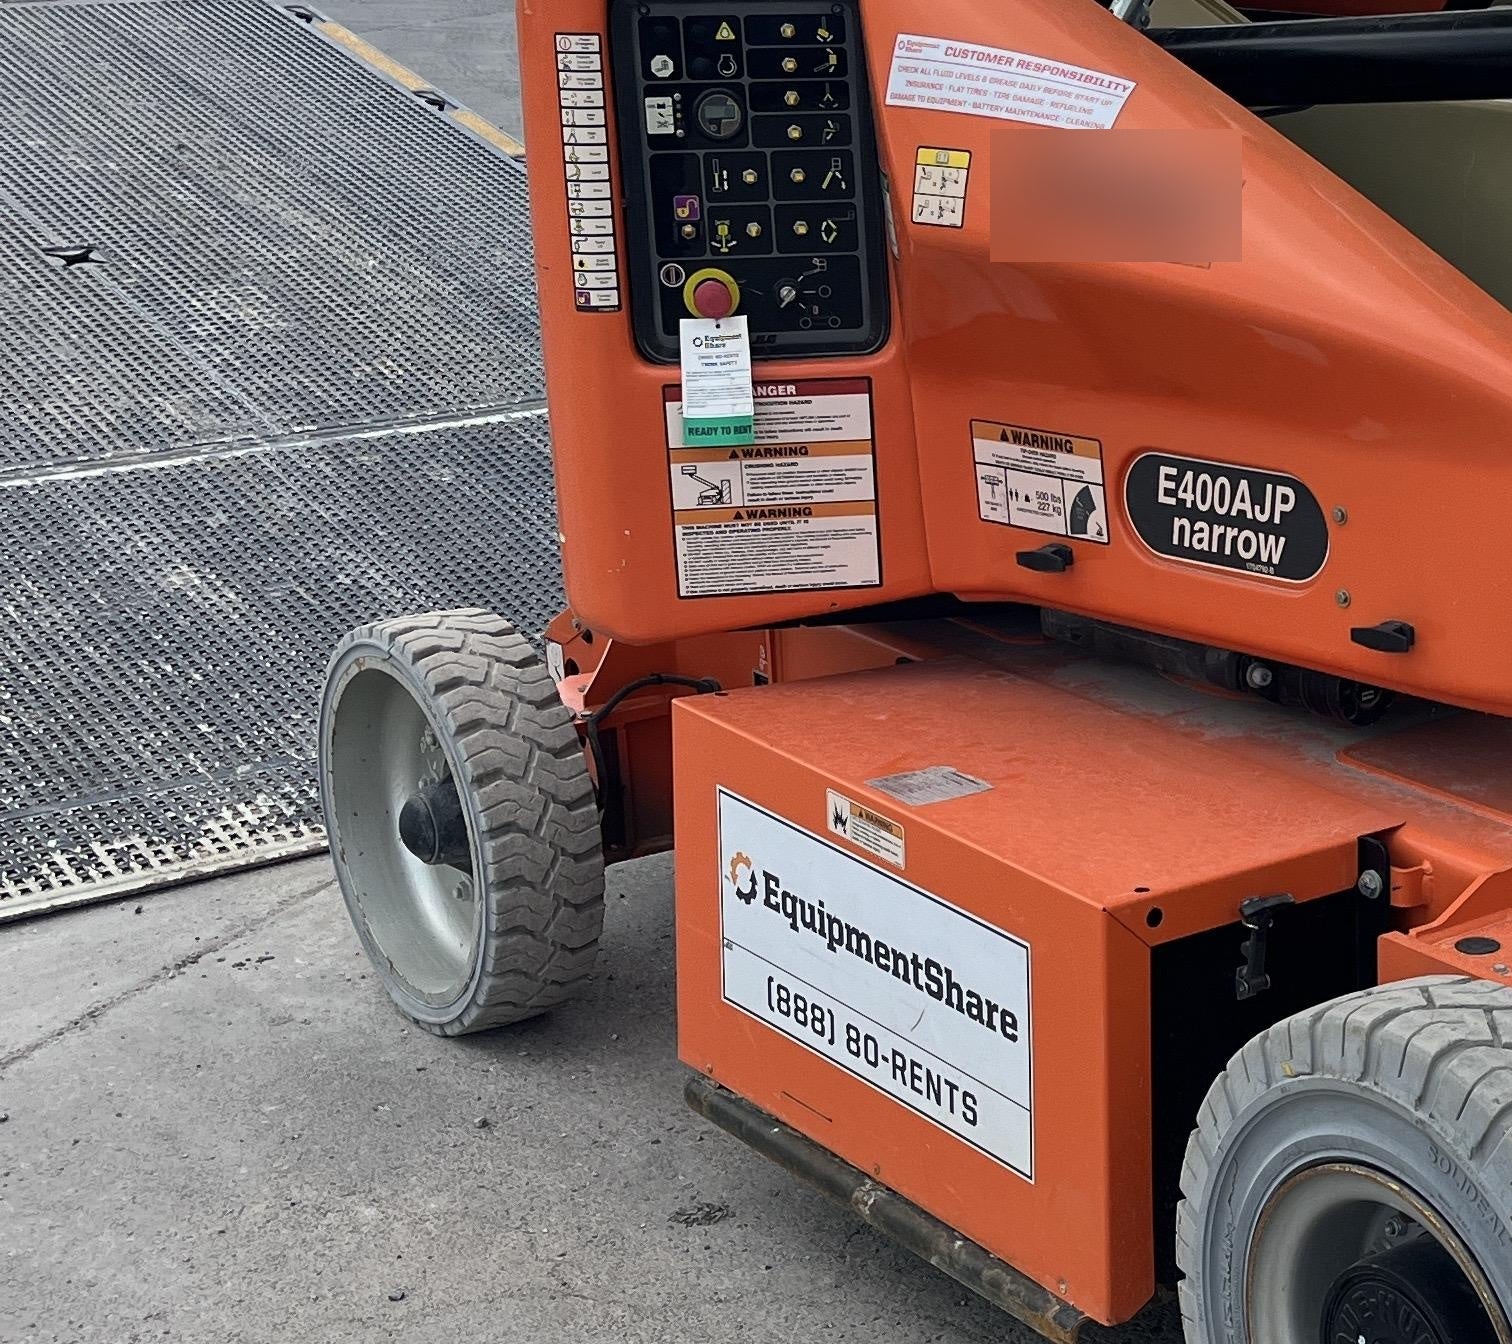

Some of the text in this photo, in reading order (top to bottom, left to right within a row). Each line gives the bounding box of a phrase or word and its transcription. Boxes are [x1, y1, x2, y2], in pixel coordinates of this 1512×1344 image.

[897, 65, 919, 74] CHECK
[919, 67, 932, 76] ALL
[932, 68, 954, 78] FLUID
[955, 70, 982, 83] LEVELS
[988, 76, 1019, 90] GREASE
[1043, 86, 1075, 99] BEFORE
[1074, 93, 1100, 105] START
[945, 46, 1132, 93] CUSTOMER RESPONSIBILITY
[890, 91, 916, 103] DAMAGE
[916, 94, 926, 103] TO
[926, 96, 968, 109] EQUIPMENT
[971, 100, 1004, 113] BATTERY
[1004, 106, 1060, 123] MAINTENANCE
[904, 79, 945, 91] INSURANCE
[948, 84, 966, 94] FLAT
[966, 86, 989, 97] TIRES
[1012, 94, 1046, 106] DAMAGE
[1049, 101, 1095, 116] REFUELING
[688, 424, 753, 437] READY TO RENT
[1010, 429, 1074, 454] WARNING
[741, 445, 809, 459] WARNING
[1035, 490, 1062, 504] 500 lbs
[1037, 501, 1050, 512] 227
[1052, 503, 1062, 517] kg
[1157, 465, 1296, 525] E400AJP
[746, 506, 813, 520] WARNING
[1172, 515, 1287, 565] narrow
[761, 869, 1019, 1043] EquipmentShare
[766, 976, 979, 1127] (888) 80-RENTS
